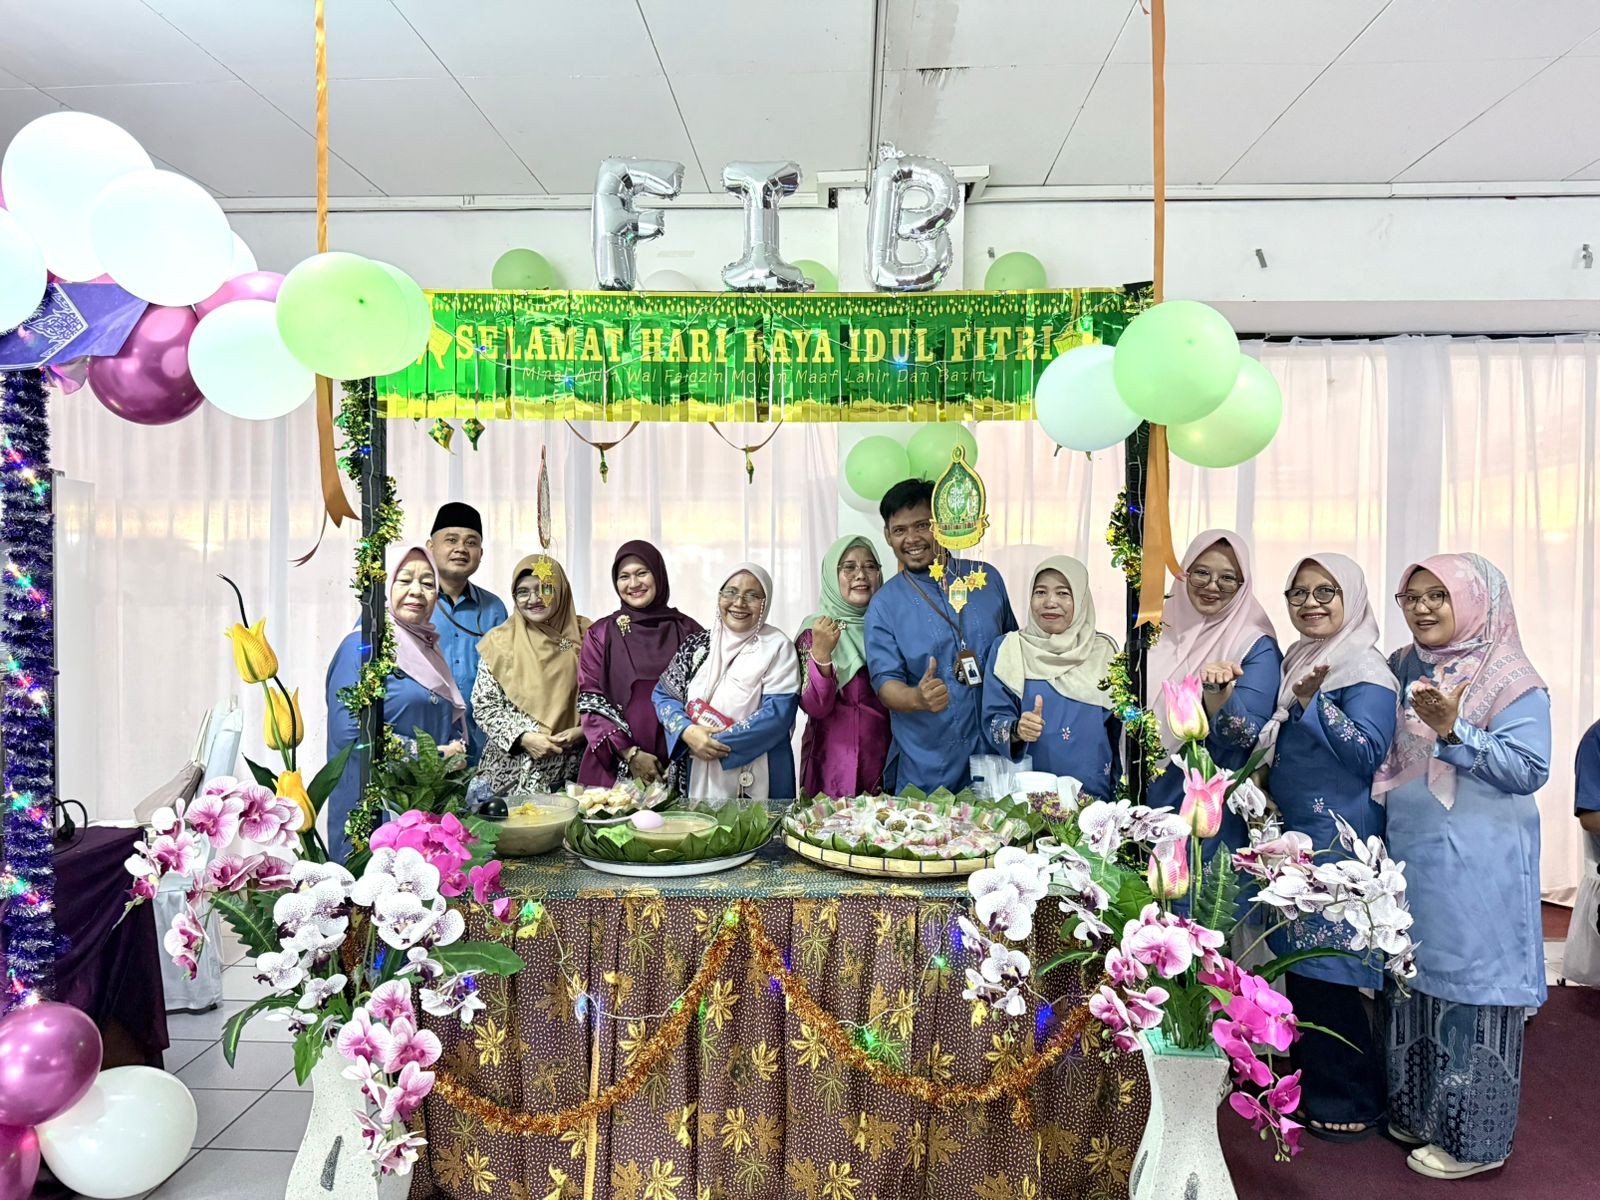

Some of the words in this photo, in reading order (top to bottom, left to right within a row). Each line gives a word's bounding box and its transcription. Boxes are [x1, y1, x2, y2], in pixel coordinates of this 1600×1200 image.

[592, 141, 960, 292] FIB
[455, 324, 625, 361] SELAMAT
[640, 328, 728, 363] HARI
[743, 329, 835, 363] RAYA
[848, 328, 934, 362] IDUL
[951, 326, 1054, 361] FITRI
[523, 366, 569, 382] Minal
[575, 367, 619, 382] Aidn
[627, 366, 657, 383] Wal
[664, 368, 724, 383] Faidzin
[795, 369, 839, 384] Maaf
[844, 369, 890, 383] Lahir
[897, 369, 930, 383] Dan
[937, 368, 986, 382] Batin
